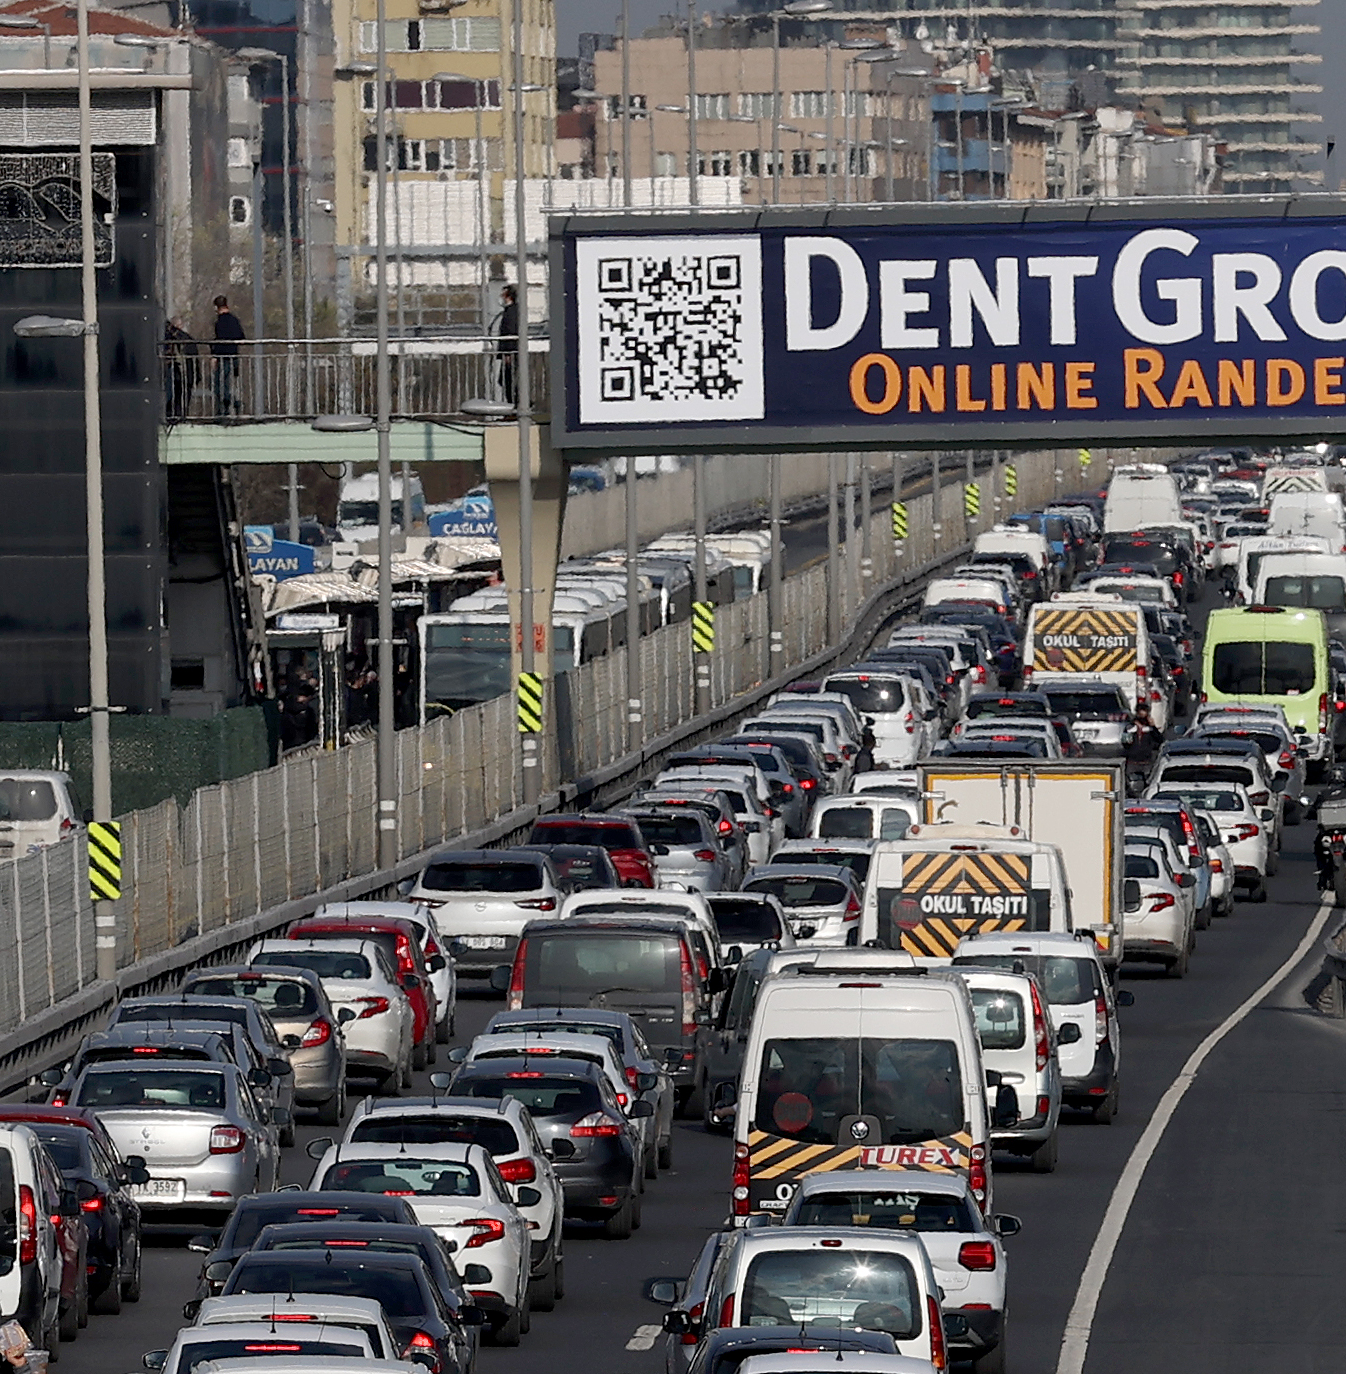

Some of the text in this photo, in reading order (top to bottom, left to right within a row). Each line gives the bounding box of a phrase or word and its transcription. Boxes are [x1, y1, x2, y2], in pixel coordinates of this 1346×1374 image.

[850, 353, 1096, 417] ONLINE
[1042, 635, 1081, 647] OKUL
[920, 895, 967, 914] OKUL
[970, 895, 1028, 919] TAŞITI
[859, 1146, 960, 1167] TUREX
